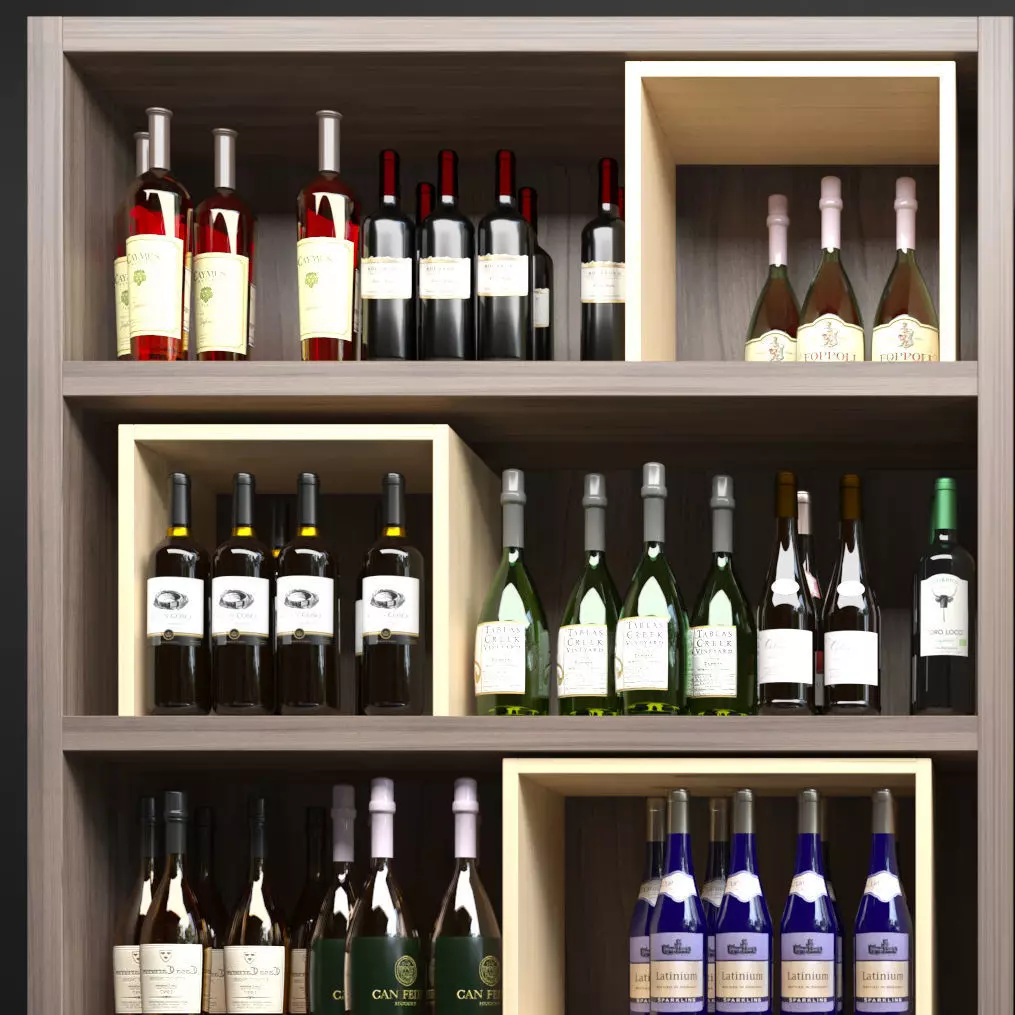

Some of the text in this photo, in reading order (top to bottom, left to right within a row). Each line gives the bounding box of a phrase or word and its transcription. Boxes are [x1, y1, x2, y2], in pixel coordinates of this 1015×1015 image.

[655, 971, 697, 981] Latinium
[721, 971, 763, 981] Latinium
[787, 971, 829, 981] Latinium
[862, 971, 904, 981] Latinium
[372, 989, 399, 1001] CAN
[456, 989, 483, 1001] CAN
